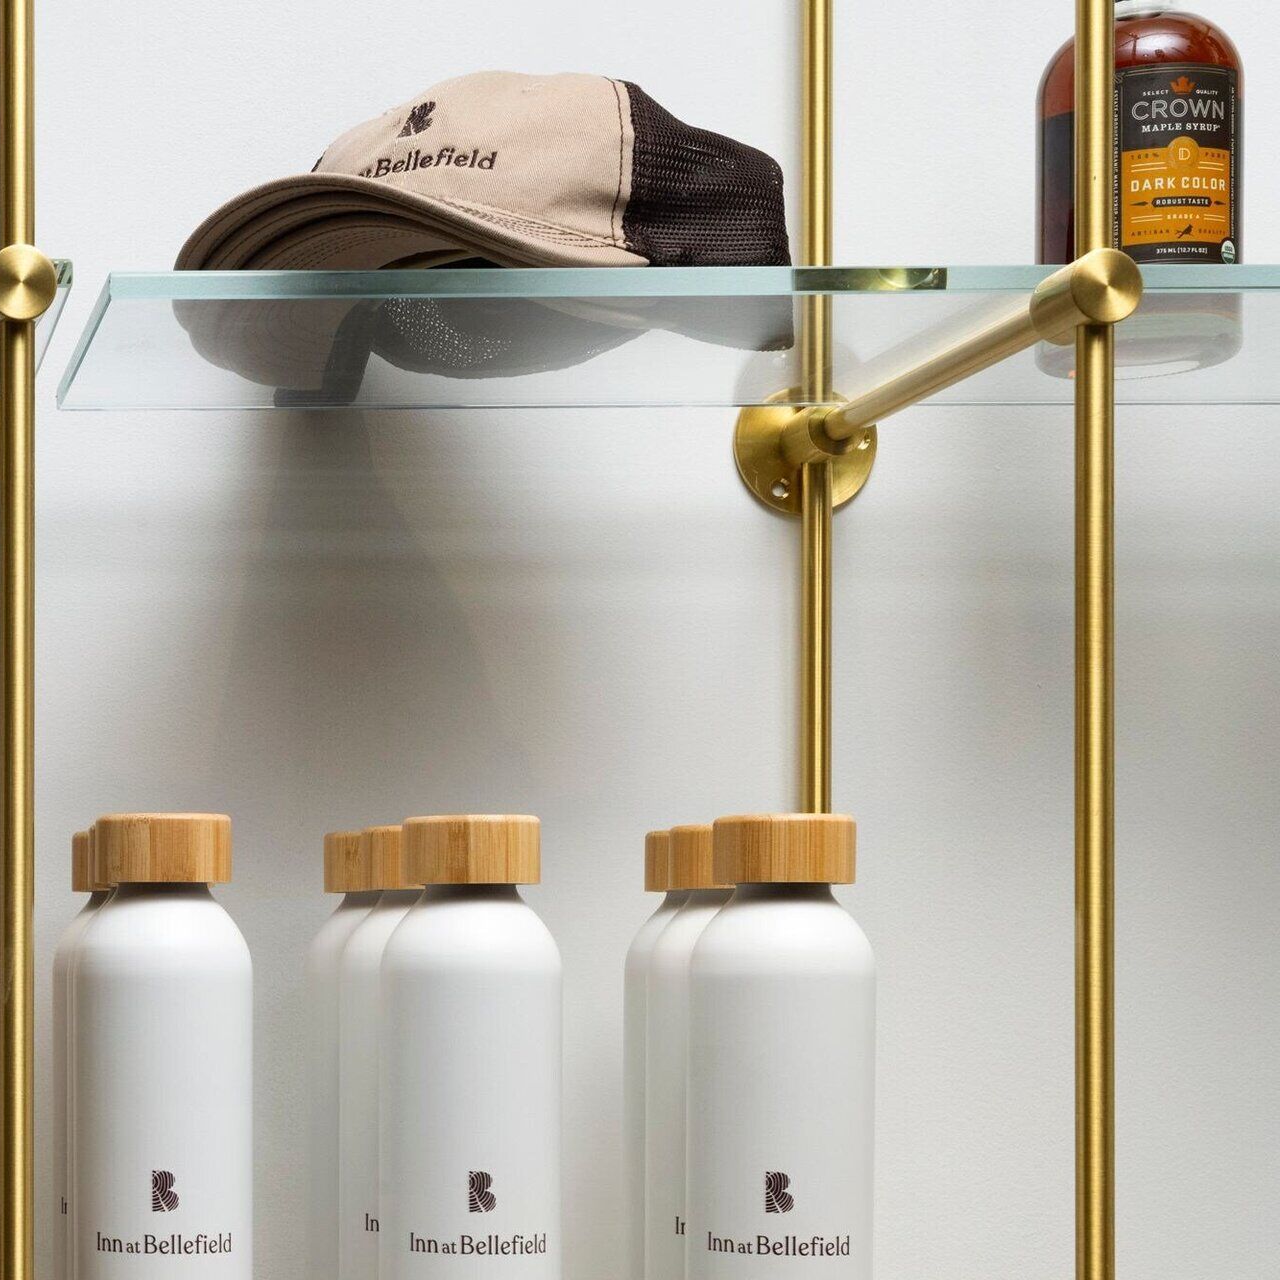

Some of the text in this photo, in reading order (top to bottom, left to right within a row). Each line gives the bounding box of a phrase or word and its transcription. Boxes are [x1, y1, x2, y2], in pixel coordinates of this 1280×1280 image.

[1132, 98, 1224, 120] CROWN
[1142, 122, 1217, 133] MAPLE SYRUP
[373, 147, 497, 178] Bellefield
[1131, 177, 1225, 192] DARK COLOR
[96, 1232, 232, 1254] Inn at Bellefield
[410, 1232, 546, 1255] Inn at Bellefield
[708, 1232, 850, 1256] Inn at Bellefield
